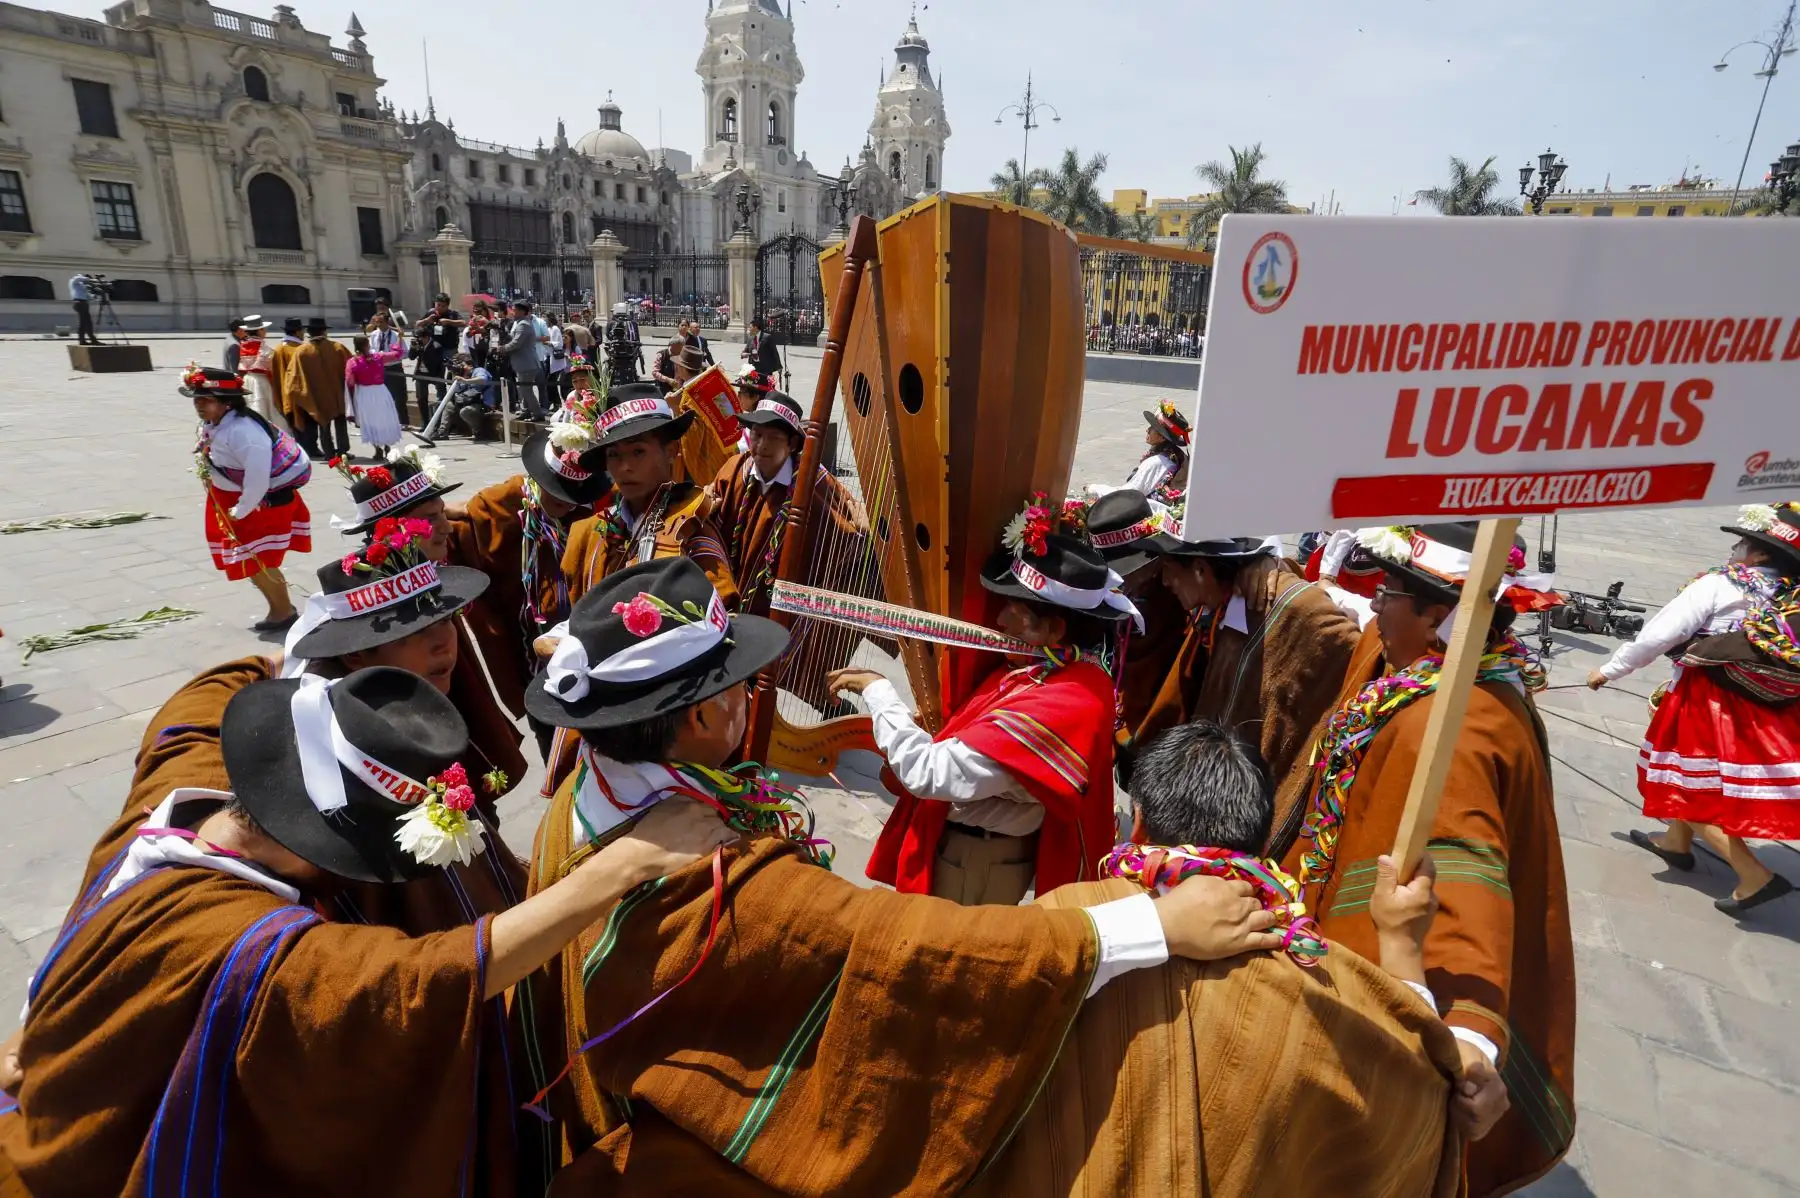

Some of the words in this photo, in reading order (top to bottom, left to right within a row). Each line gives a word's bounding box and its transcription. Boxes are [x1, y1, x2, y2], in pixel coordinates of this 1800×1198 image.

[1297, 321, 1582, 375] MUNICIPALIDAD
[1581, 316, 1783, 367] PROVINCIAL
[1384, 378, 1714, 458] LUCANAS
[1439, 469, 1652, 508] HUAYCAHUACHO
